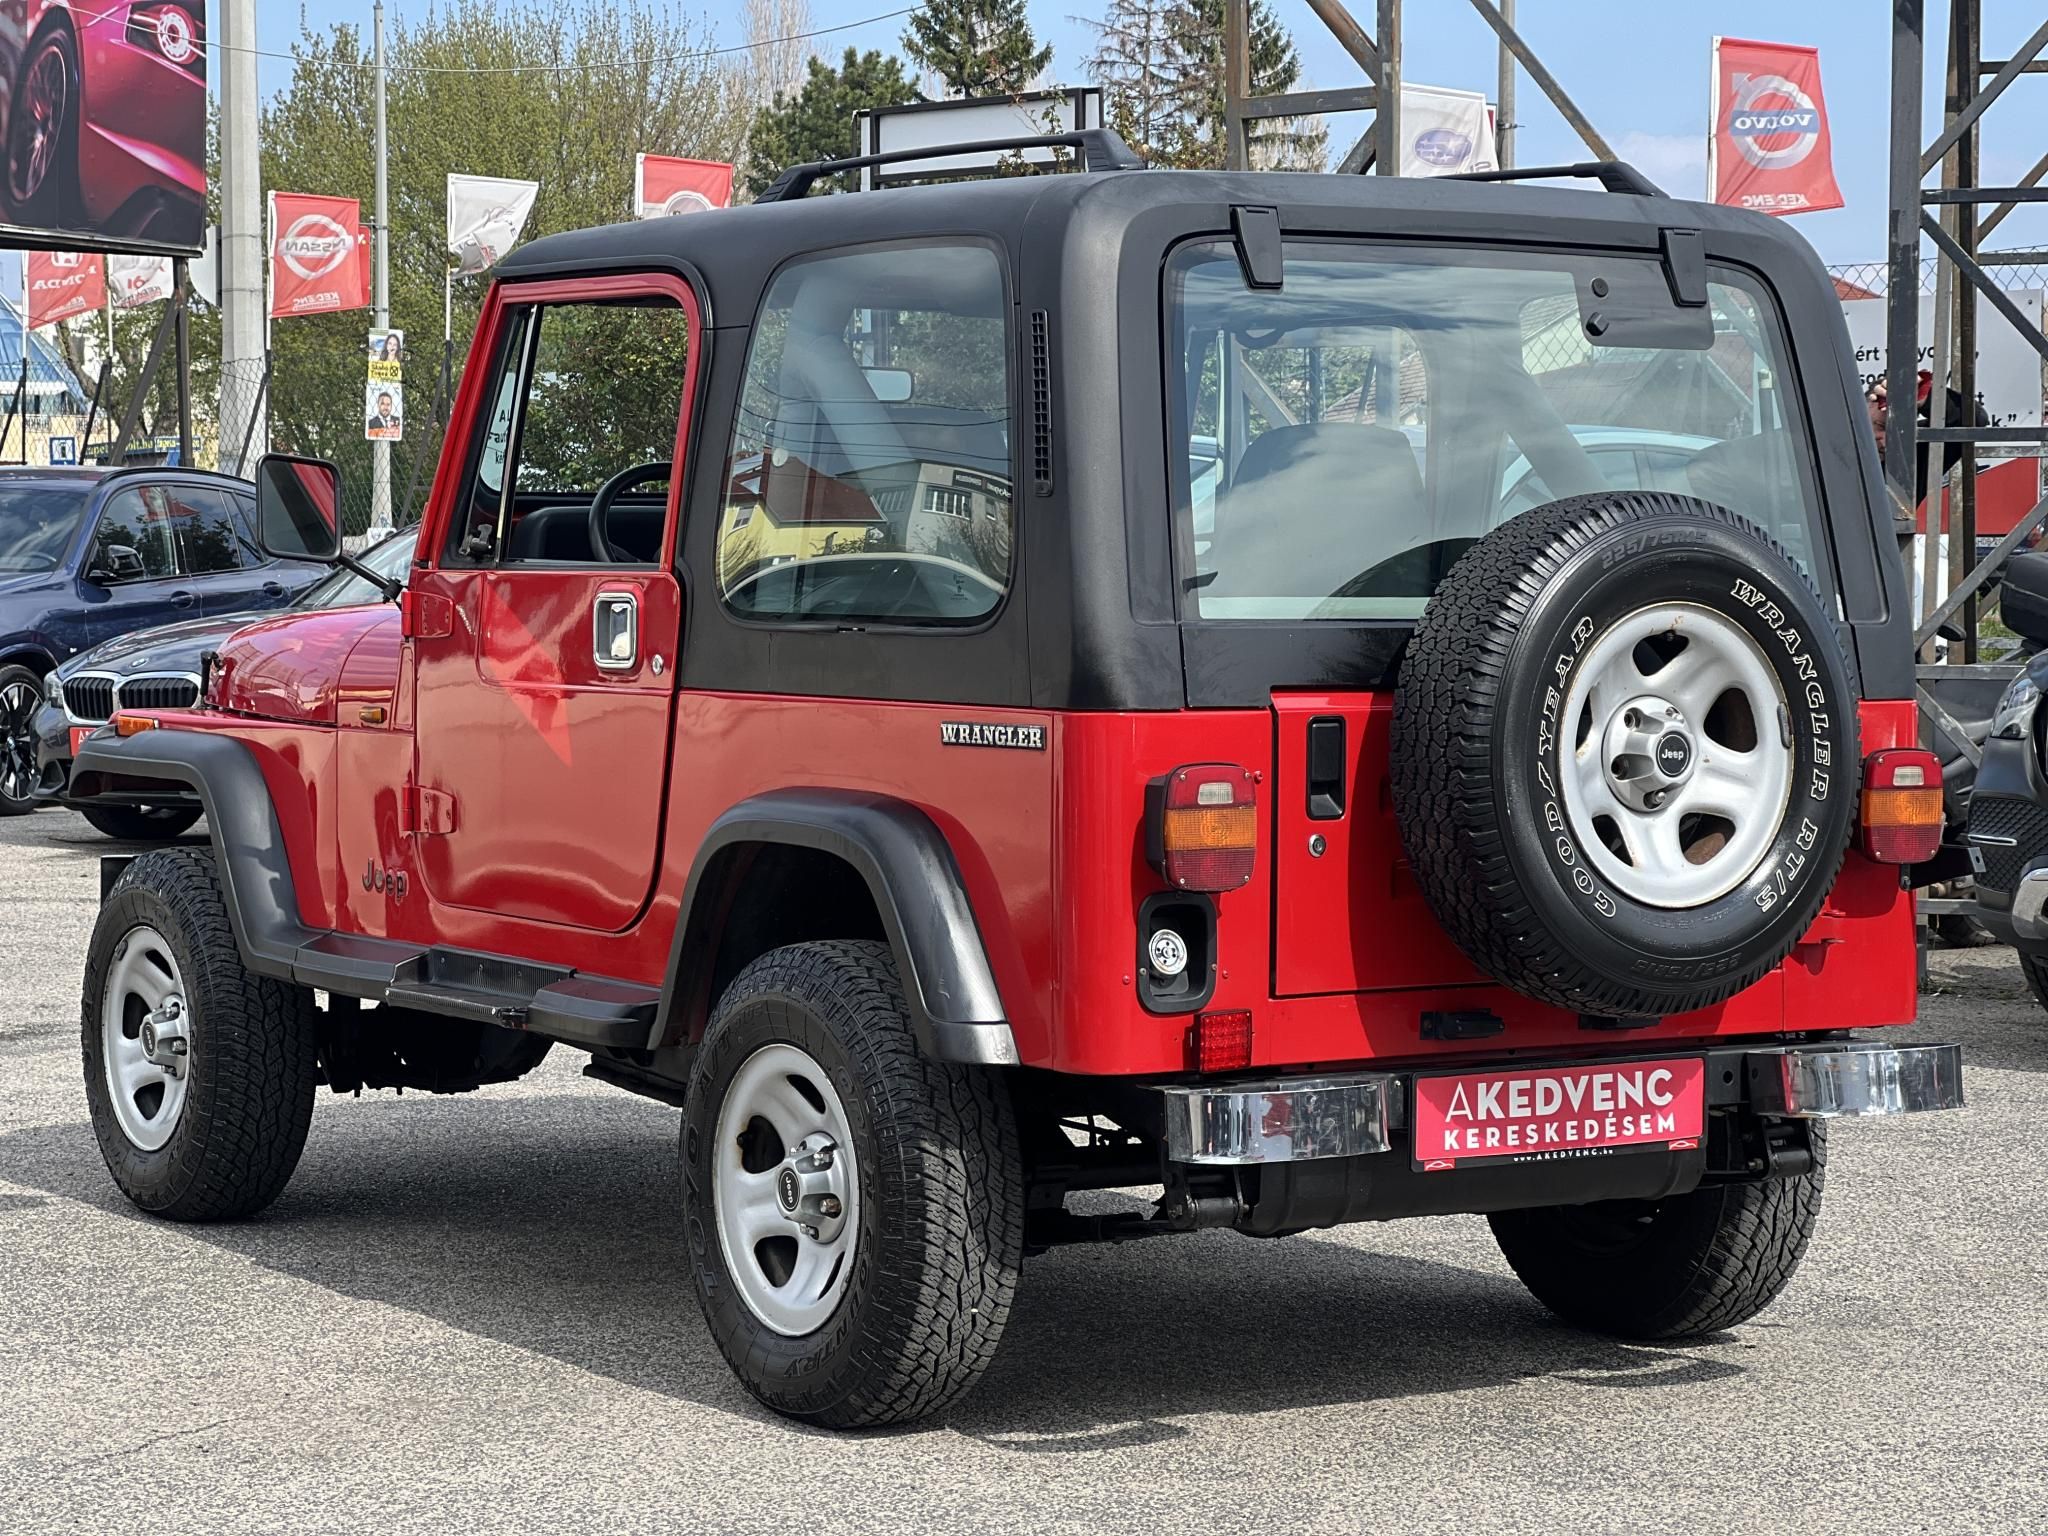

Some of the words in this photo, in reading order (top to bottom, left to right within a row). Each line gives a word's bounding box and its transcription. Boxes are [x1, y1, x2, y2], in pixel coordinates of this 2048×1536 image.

[1730, 578, 1831, 801] WRANGLER
[941, 722, 1042, 748] WRANGLER
[1661, 748, 1684, 761] Jeep
[362, 858, 408, 905] Jeep
[1754, 818, 1818, 912] RT/S
[1444, 1111, 1676, 1151] KERESKEDÉSEM
[785, 1176, 794, 1204] Jeep
